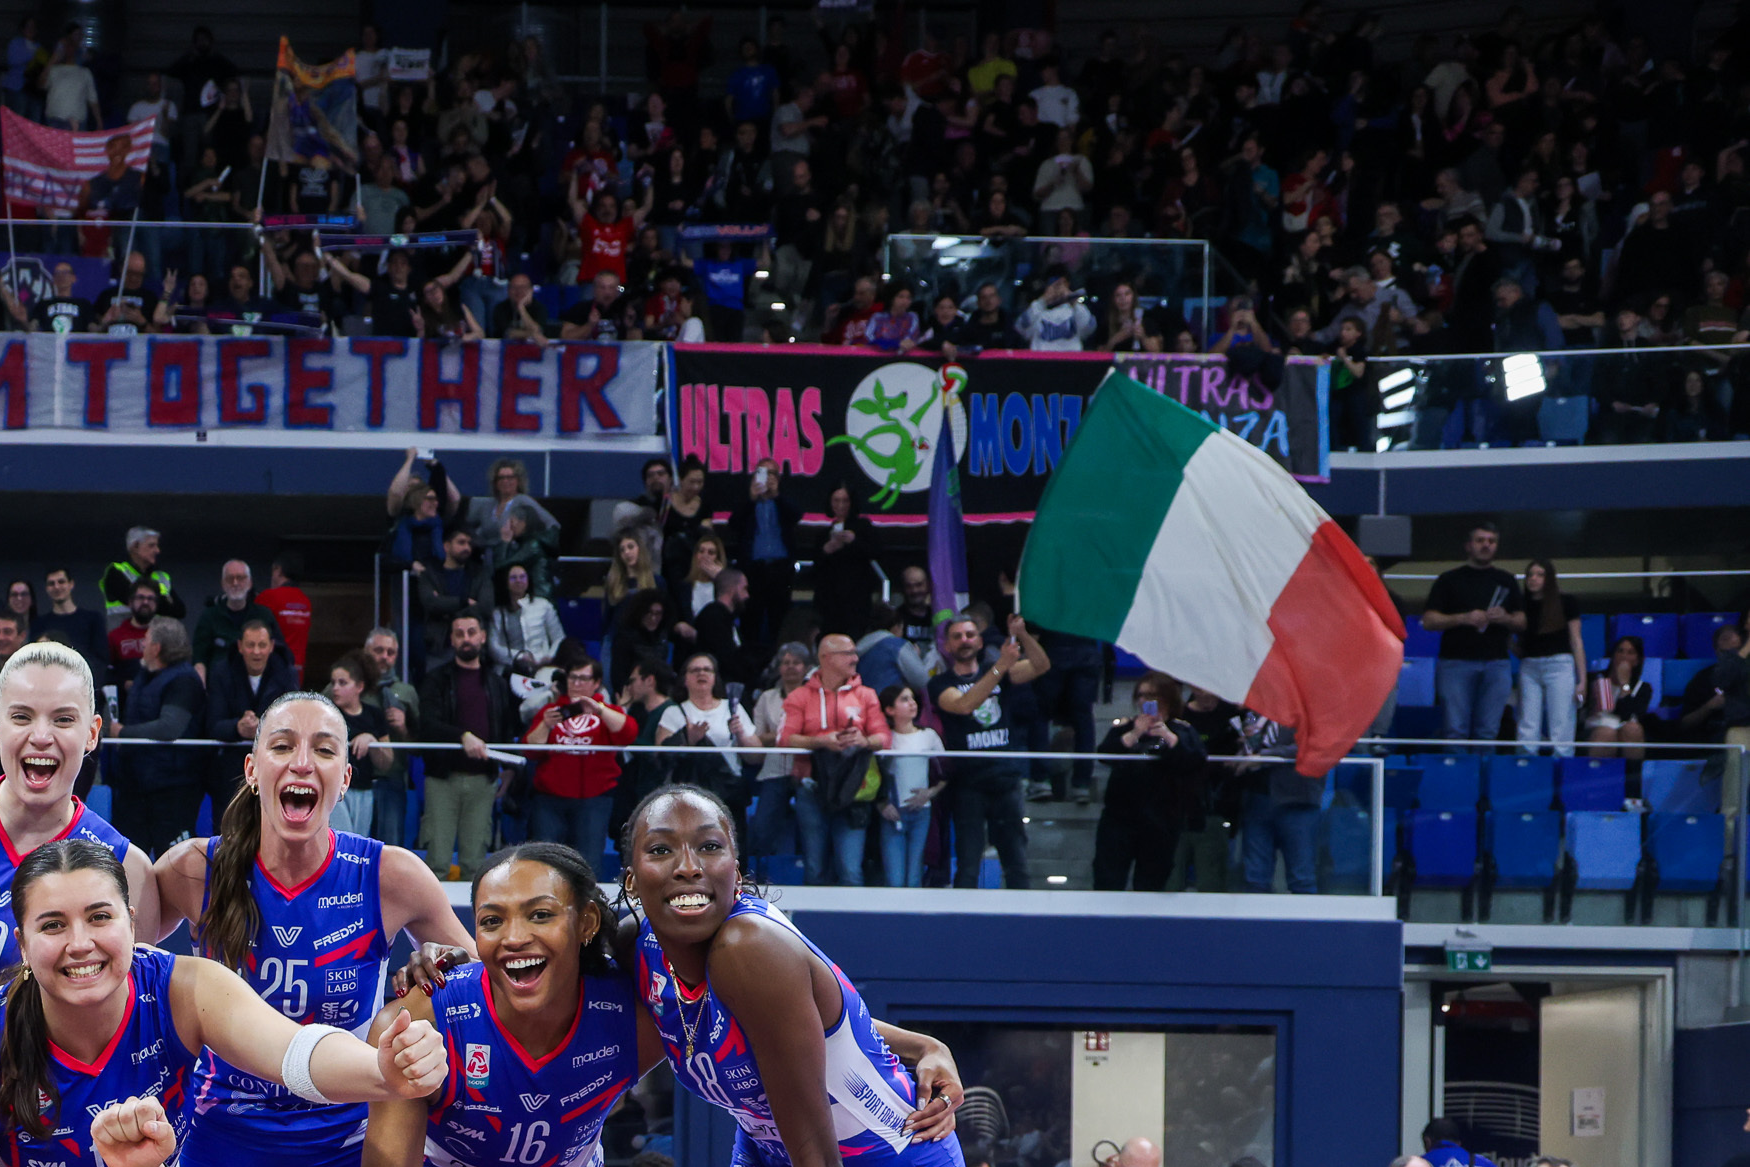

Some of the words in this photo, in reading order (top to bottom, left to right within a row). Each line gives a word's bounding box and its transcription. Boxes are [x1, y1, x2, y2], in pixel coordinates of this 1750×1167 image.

[66, 337, 625, 433] TOGETHER
[680, 383, 824, 477] ULTRAS
[968, 392, 1085, 477] MONZ
[79, 826, 115, 851] KGM
[336, 850, 371, 865] KGM
[317, 891, 364, 909] mauden
[312, 917, 365, 951] FREDDY
[326, 968, 358, 981] SKIN
[259, 956, 309, 1018] 25
[326, 981, 358, 994] LABO
[587, 1000, 624, 1013] KGM
[571, 1044, 621, 1069] mauden
[724, 1064, 753, 1080] SKIN
[559, 1070, 614, 1108] FREDDY
[730, 1077, 760, 1092] LABO
[446, 1119, 488, 1142] SYM
[498, 1120, 551, 1166] 16
